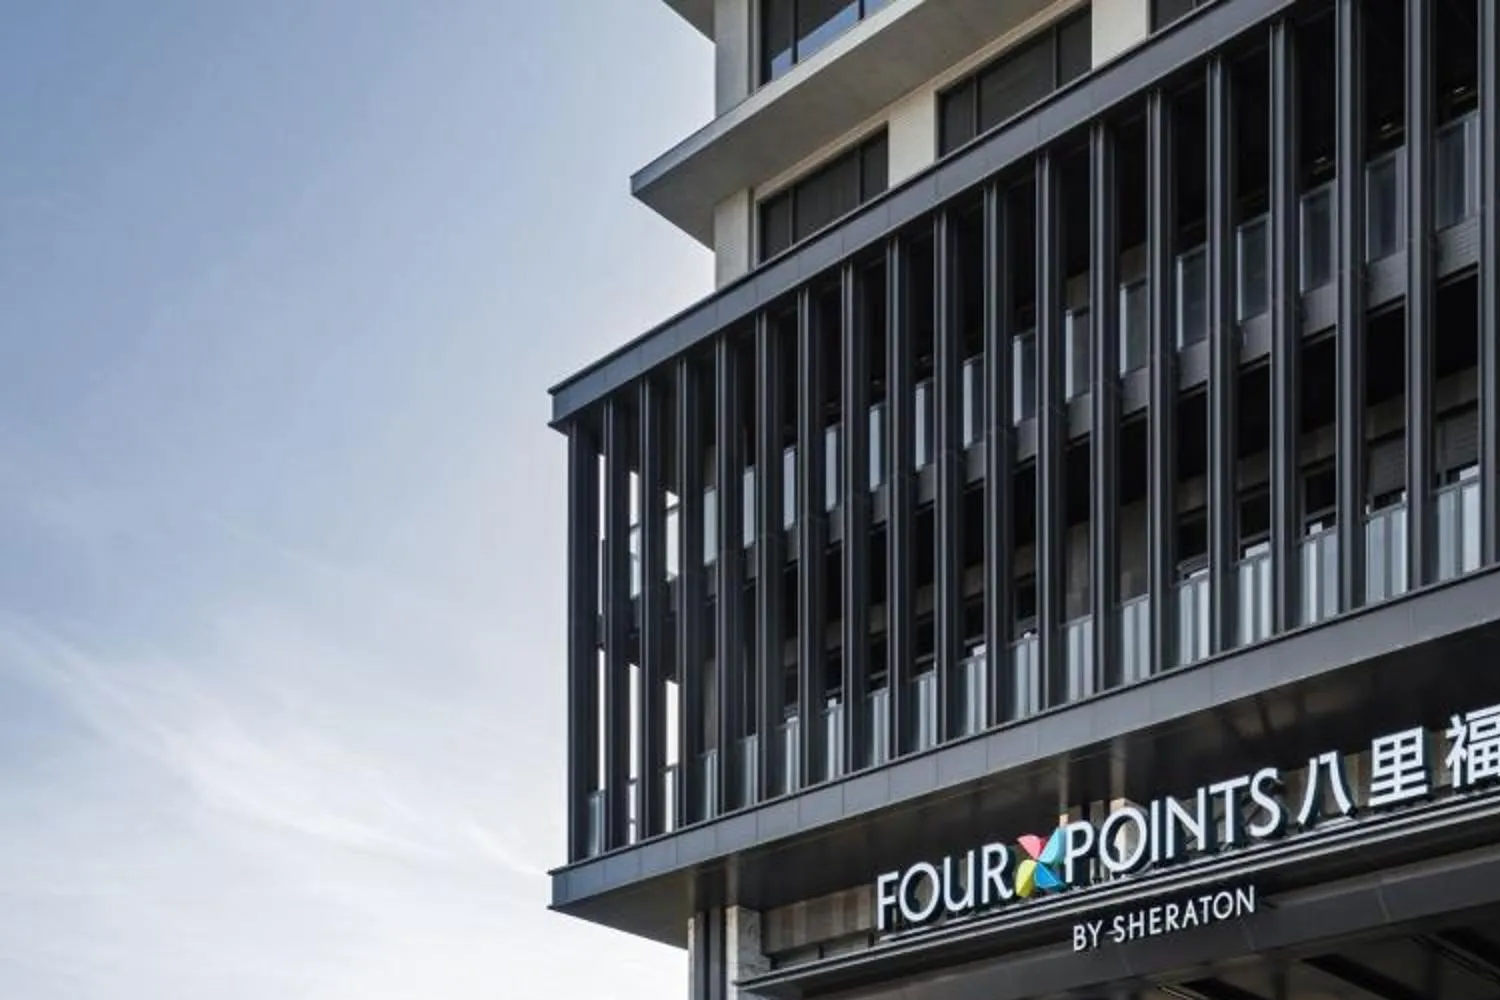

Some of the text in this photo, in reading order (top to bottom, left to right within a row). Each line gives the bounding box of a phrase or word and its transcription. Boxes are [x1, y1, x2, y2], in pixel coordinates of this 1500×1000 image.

[875, 767, 1284, 931] FOUR POINTS
[1073, 885, 1256, 951] BY SHERATON
